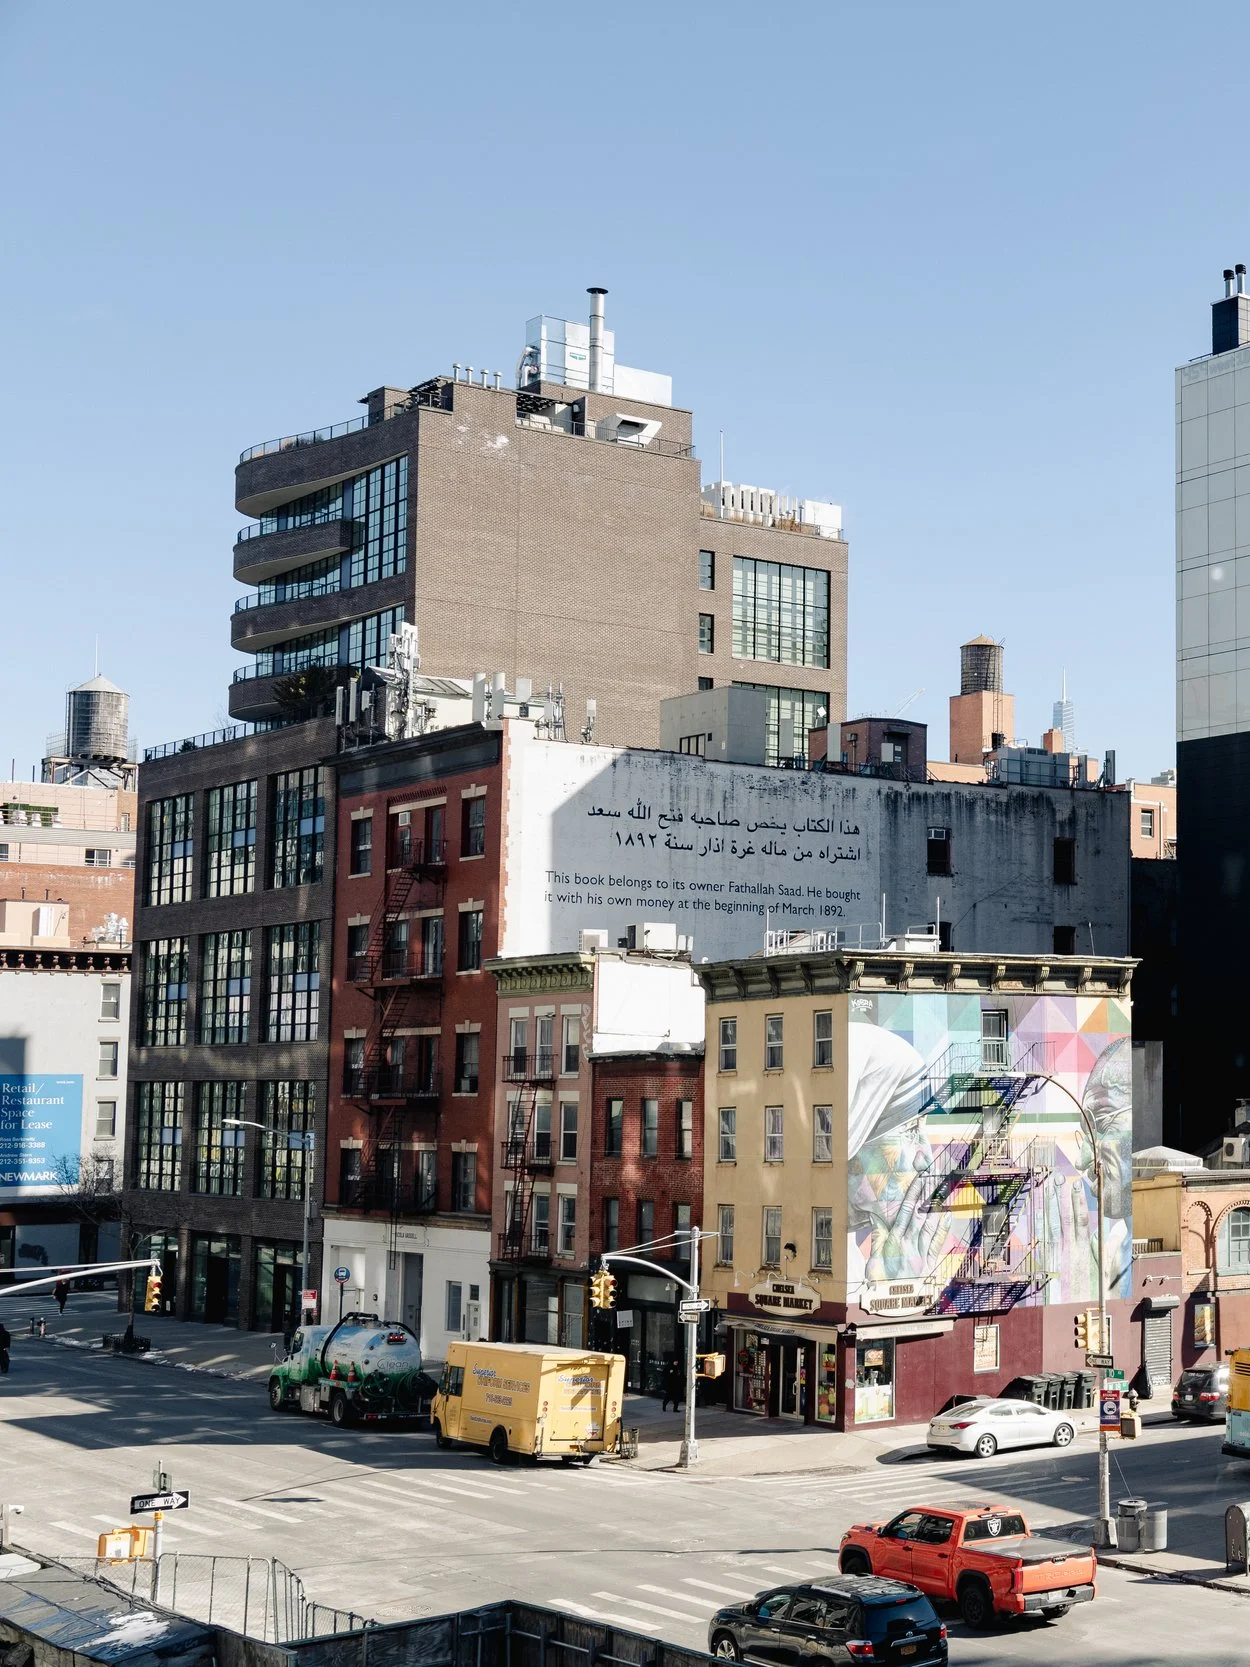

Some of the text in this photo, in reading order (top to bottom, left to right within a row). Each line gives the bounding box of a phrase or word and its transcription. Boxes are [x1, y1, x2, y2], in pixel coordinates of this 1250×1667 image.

[587, 798, 860, 838] هذا الكتاب يخص صاحبه فتح الله سعد
[615, 831, 657, 848] ١٨٩٢
[664, 833, 693, 851] سنة
[730, 840, 755, 859] غرة
[793, 845, 813, 861] من
[819, 845, 861, 864] اشتراه
[545, 871, 861, 902] This book belongs to its owner Fathallah Saad. He bought
[544, 891, 846, 917] it with his own money at the beginning of March 1892.
[2, 1080, 44, 1094] Retail/
[2, 1096, 64, 1105] Restaurant
[0, 1108, 34, 1119] Space
[0, 1119, 53, 1129] for Lease
[0, 1171, 57, 1181] NEWMARK
[772, 1284, 794, 1294] CHELSEA
[889, 1284, 914, 1295] CHELSEA
[755, 1294, 813, 1310] SQUARE MARKET
[869, 1298, 900, 1312] SQUARE
[138, 1497, 180, 1508] ONE WAY
